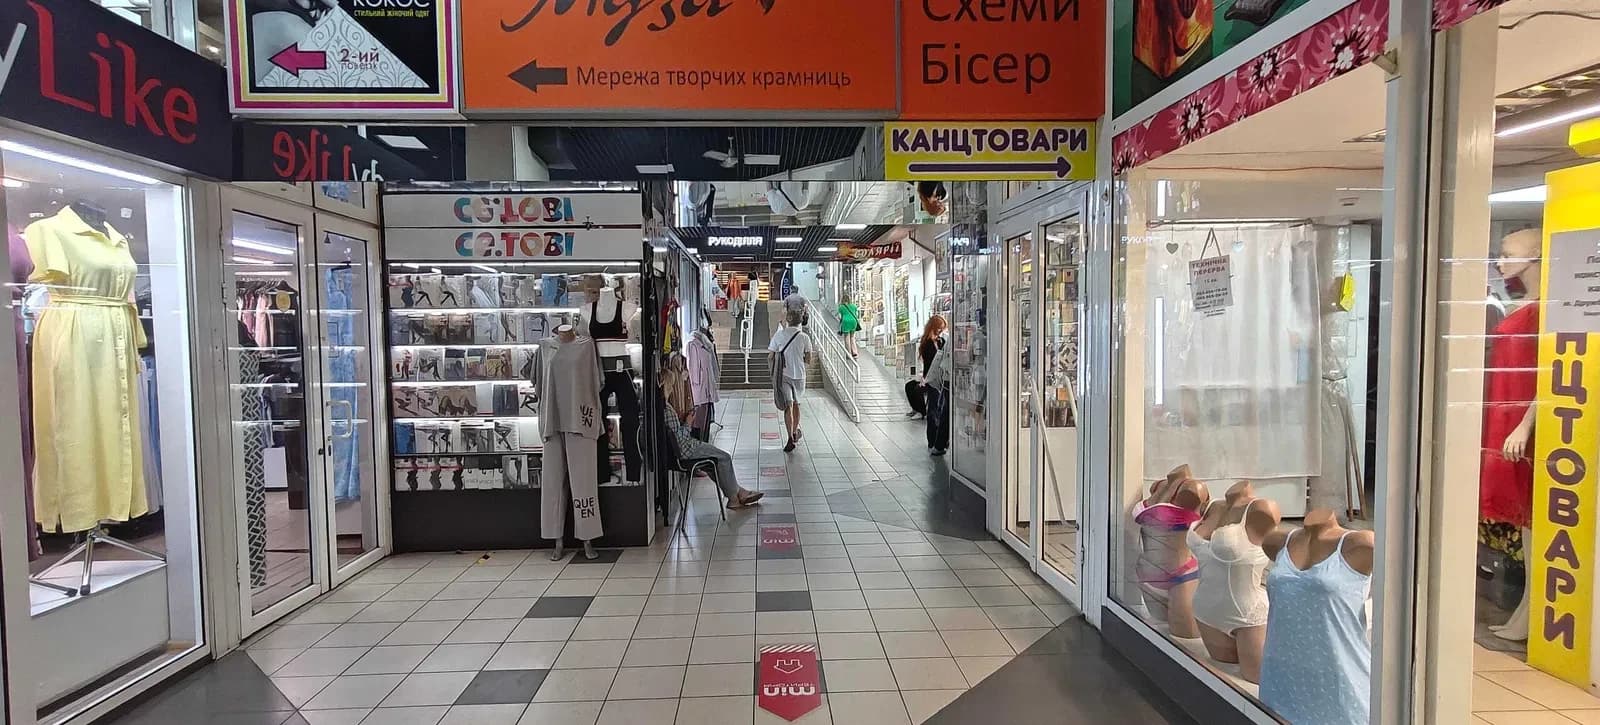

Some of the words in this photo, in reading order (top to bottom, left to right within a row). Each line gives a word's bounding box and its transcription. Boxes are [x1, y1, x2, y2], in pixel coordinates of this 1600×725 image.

[340, 47, 380, 62] 2-ий
[26, 0, 198, 145] Like
[576, 65, 661, 90] Мережа
[665, 70, 747, 90] творчих
[752, 70, 852, 90] крамниць
[921, 43, 1051, 95] Бісер
[891, 128, 1088, 157] КАНЦТОВАРИ
[1193, 266, 1226, 276] ПЕРЕРВА
[581, 509, 595, 519] EN
[763, 686, 816, 697] min
